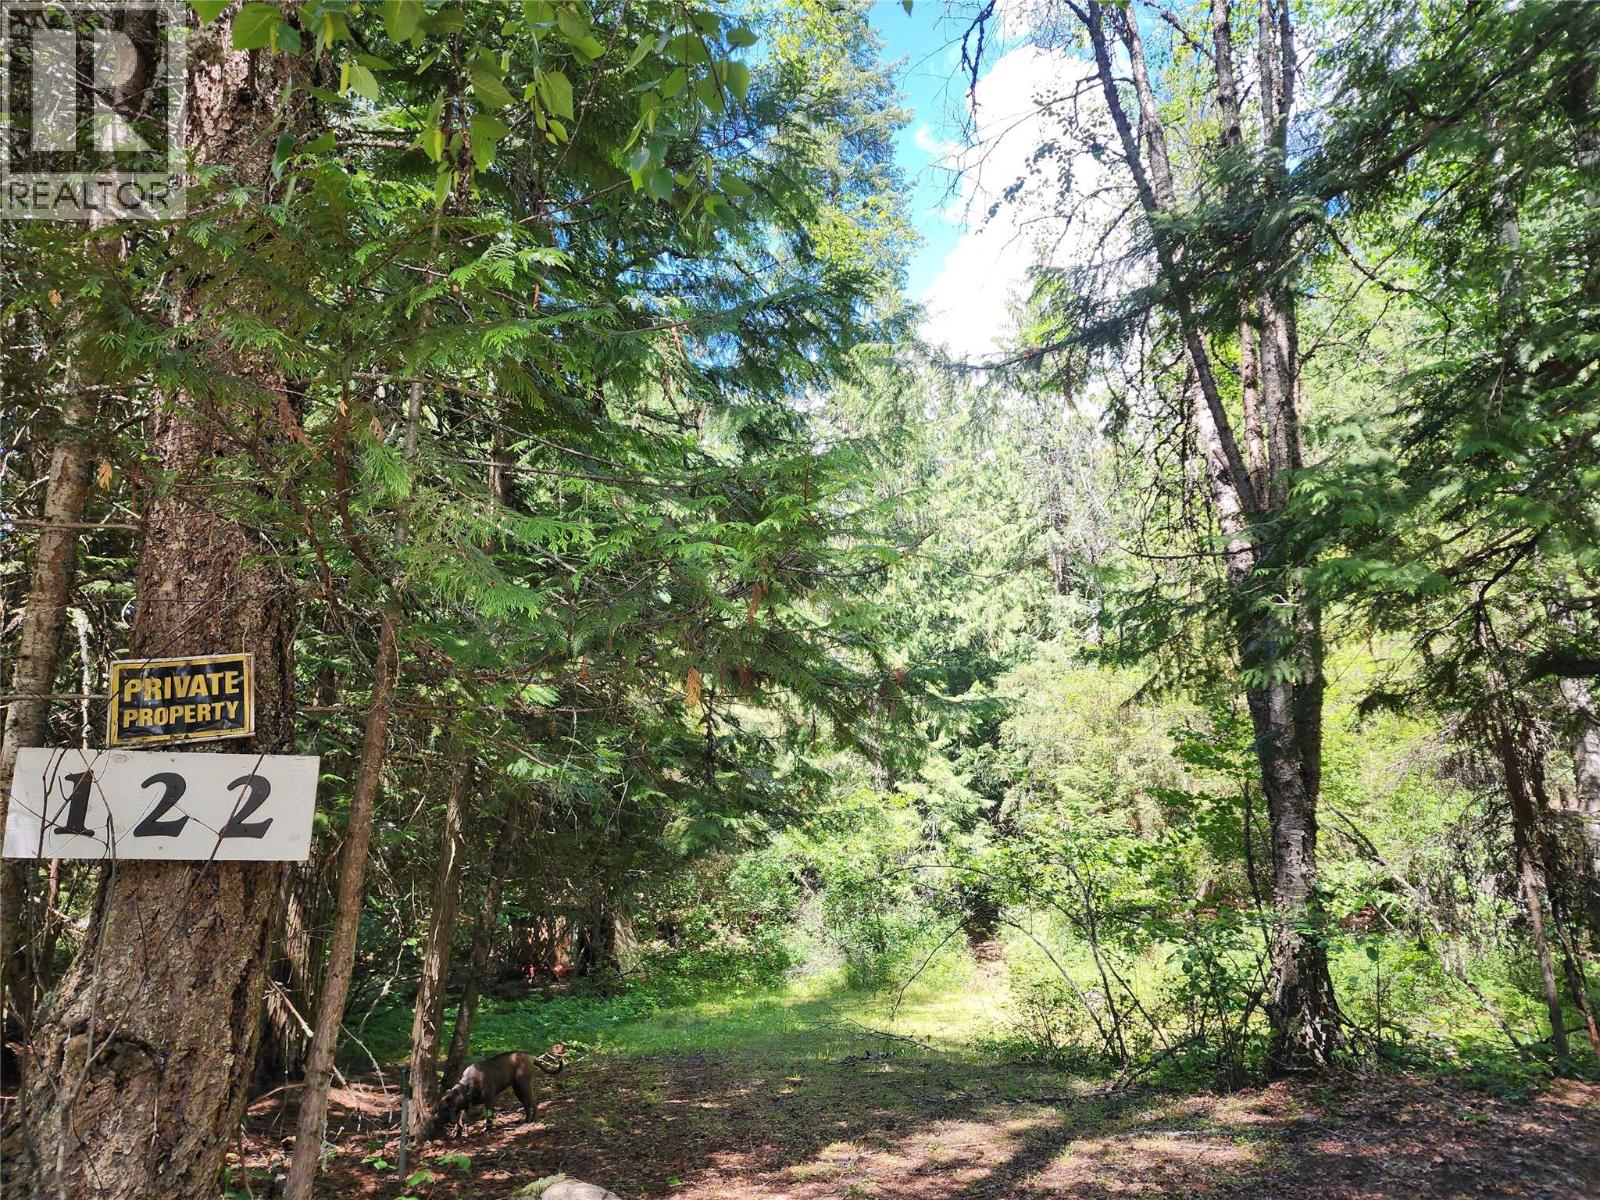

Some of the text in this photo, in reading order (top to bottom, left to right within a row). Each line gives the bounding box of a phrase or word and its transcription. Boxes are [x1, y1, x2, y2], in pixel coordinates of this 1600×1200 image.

[123, 671, 240, 702] PRIVATE
[122, 700, 239, 728] PROPERTY
[54, 769, 273, 839] 122
